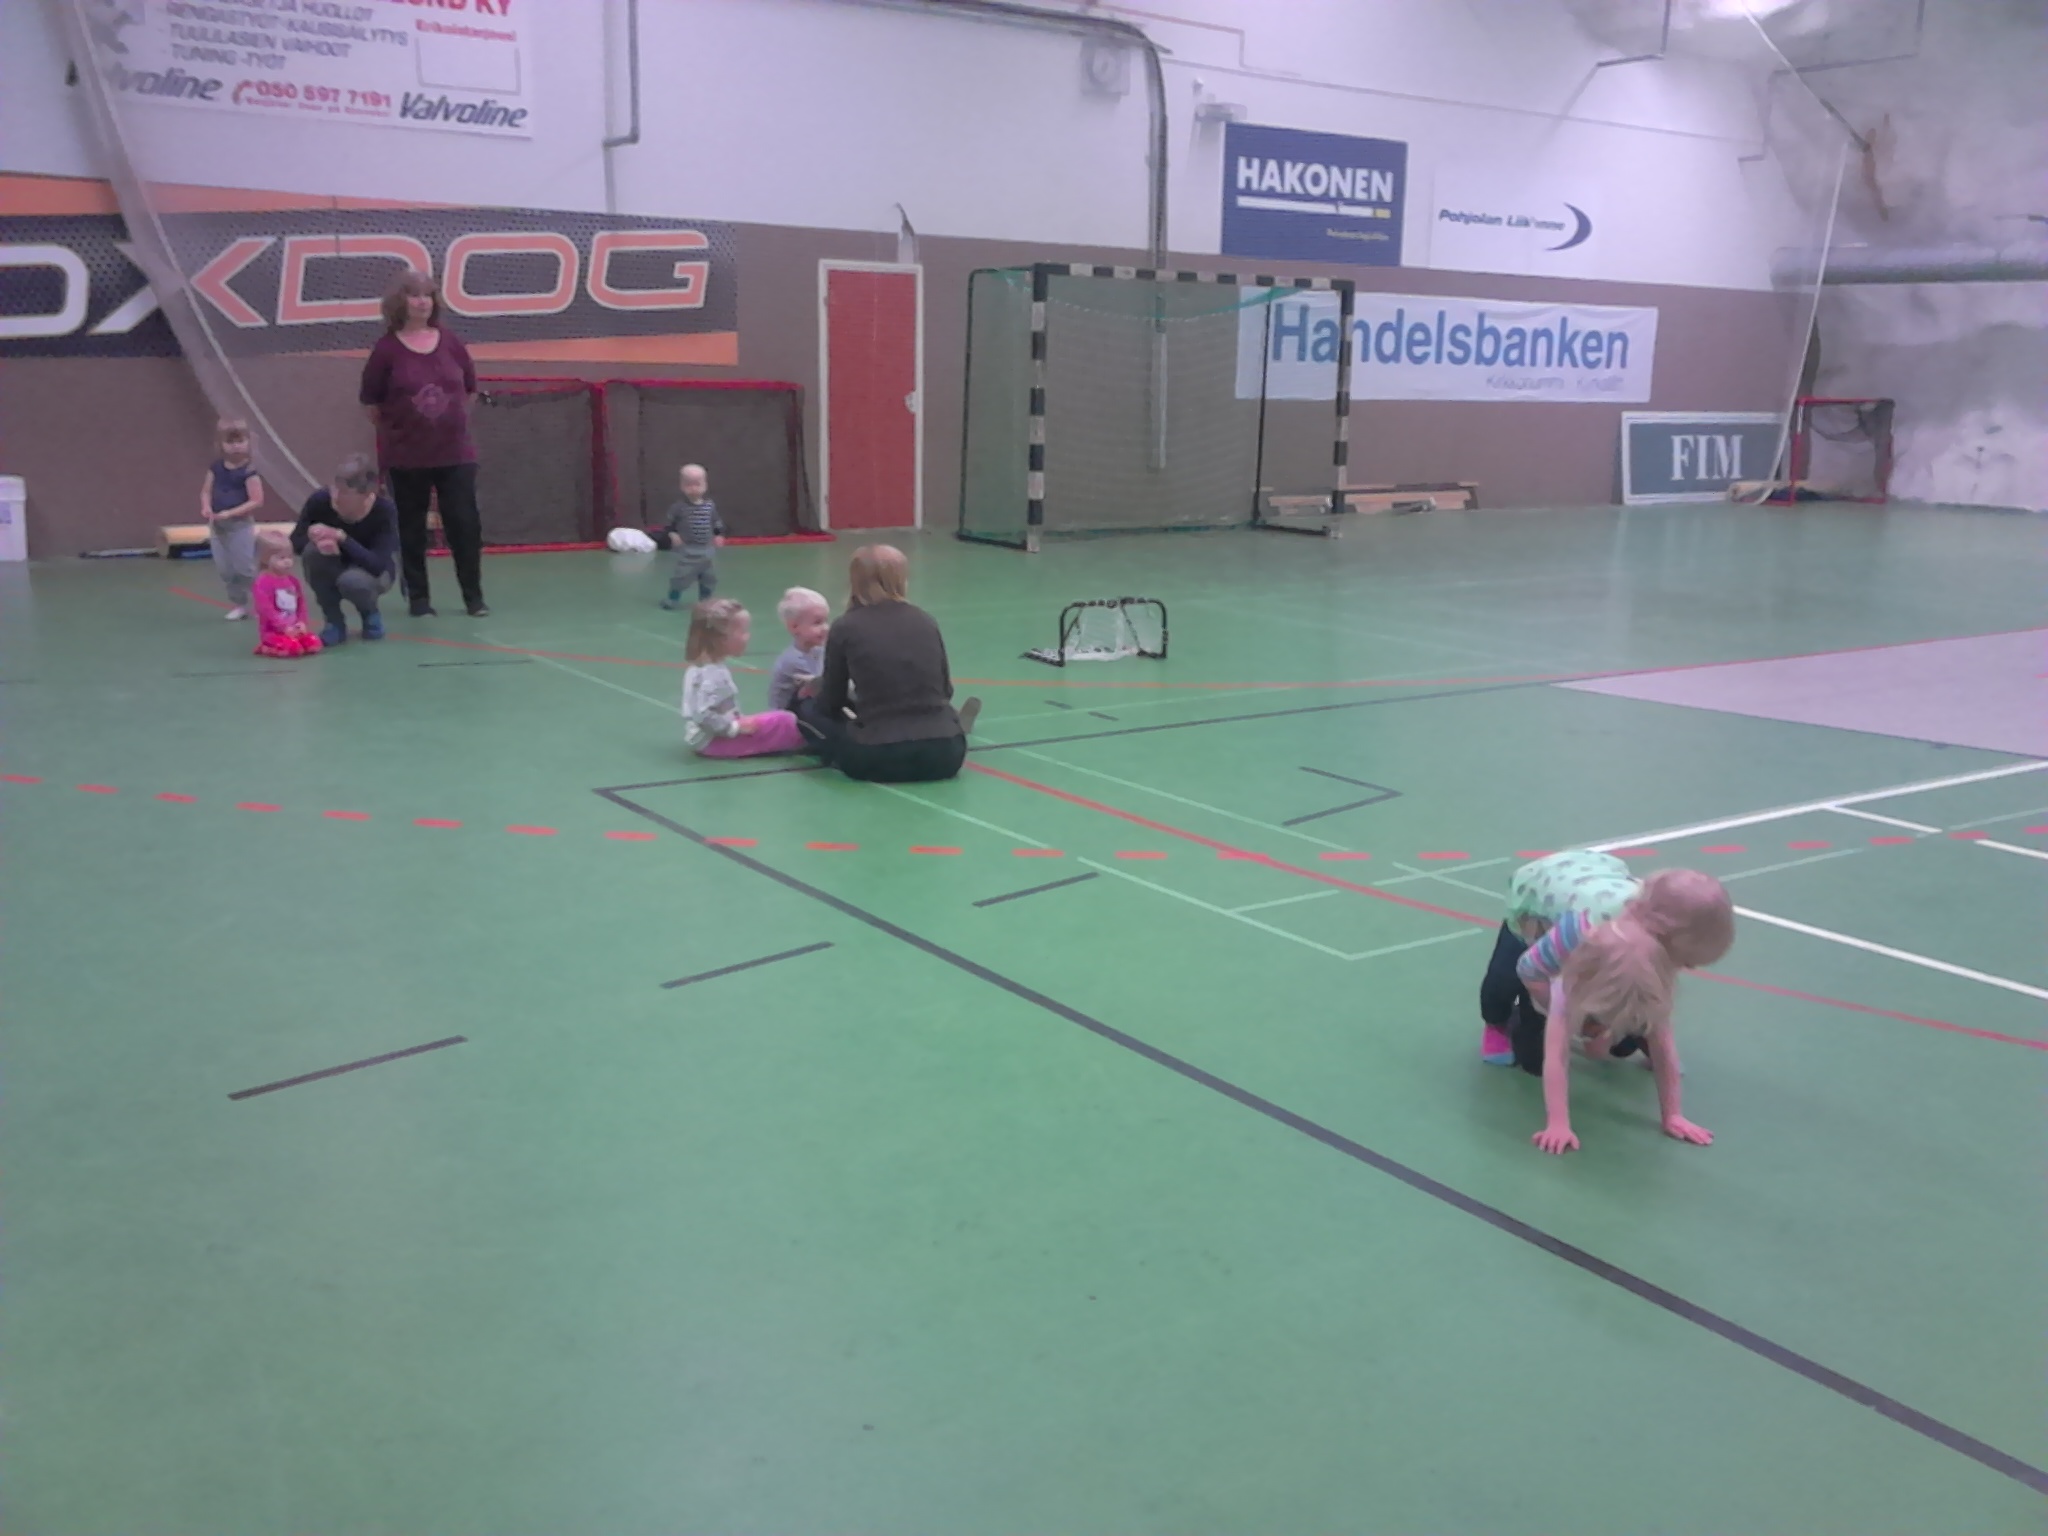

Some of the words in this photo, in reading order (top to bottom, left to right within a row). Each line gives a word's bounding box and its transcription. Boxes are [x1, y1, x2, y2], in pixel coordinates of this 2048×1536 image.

[399, 91, 529, 129] Valvoline
[1236, 155, 1394, 203] HAKONEN
[1271, 301, 1630, 371] Handelsbanken
[1670, 433, 1744, 482] FIM
